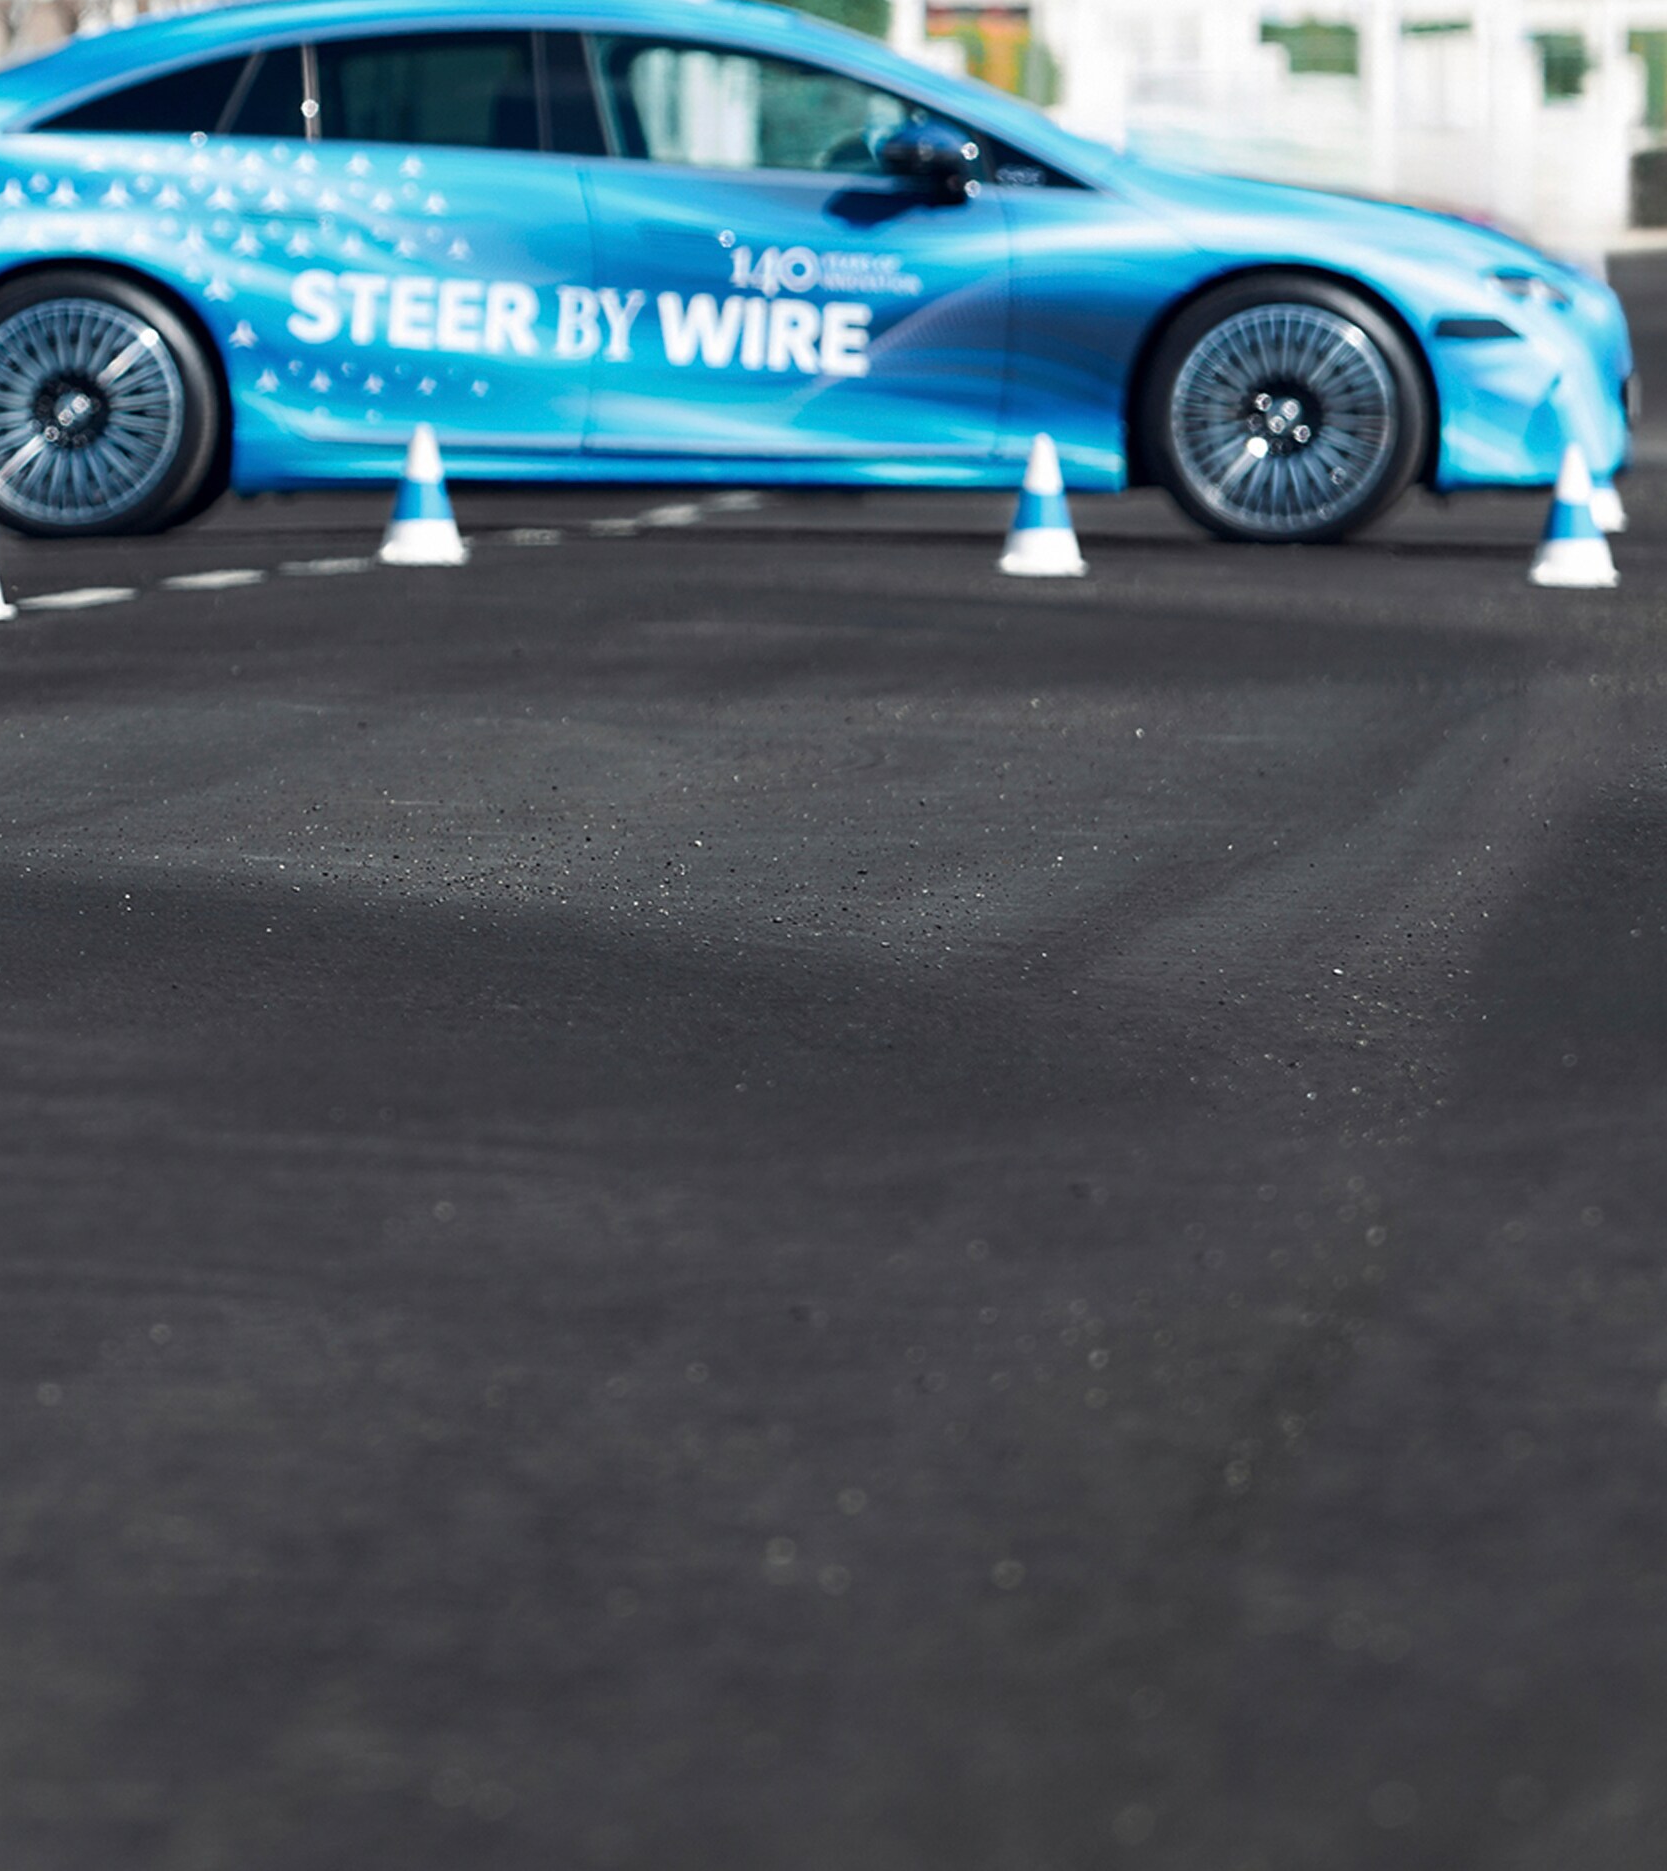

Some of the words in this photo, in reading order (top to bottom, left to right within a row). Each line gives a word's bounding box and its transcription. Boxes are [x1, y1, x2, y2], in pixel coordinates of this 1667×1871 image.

[729, 245, 820, 298] 140
[286, 268, 540, 354] STEER
[555, 285, 646, 362] BY
[658, 291, 873, 377] WIRE
